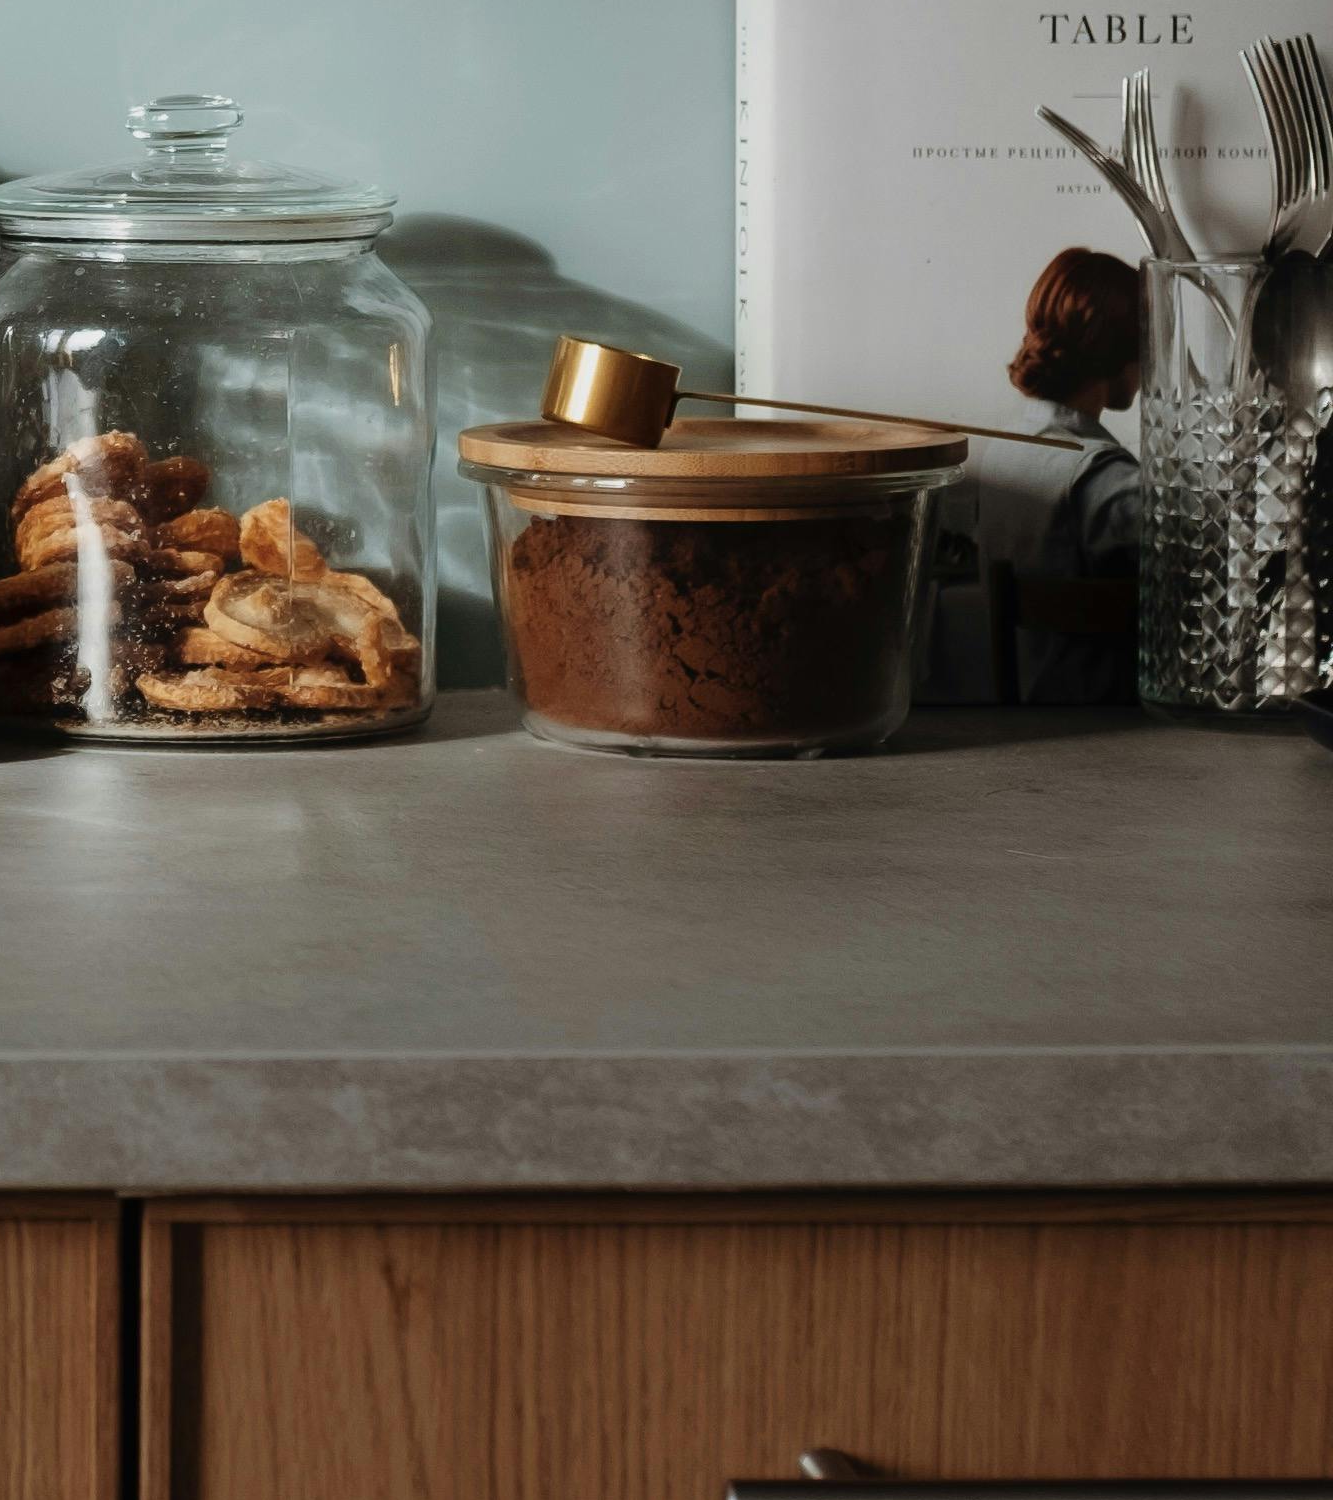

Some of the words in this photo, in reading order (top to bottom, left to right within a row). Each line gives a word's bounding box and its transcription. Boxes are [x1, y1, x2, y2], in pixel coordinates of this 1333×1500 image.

[1039, 13, 1196, 46] TABLE
[911, 146, 1001, 160] ПРОСТЫЕ
[1007, 146, 1079, 161] РЕЦЕПТ
[1217, 146, 1268, 160] КОМП
[738, 99, 750, 322] KINFOLK
